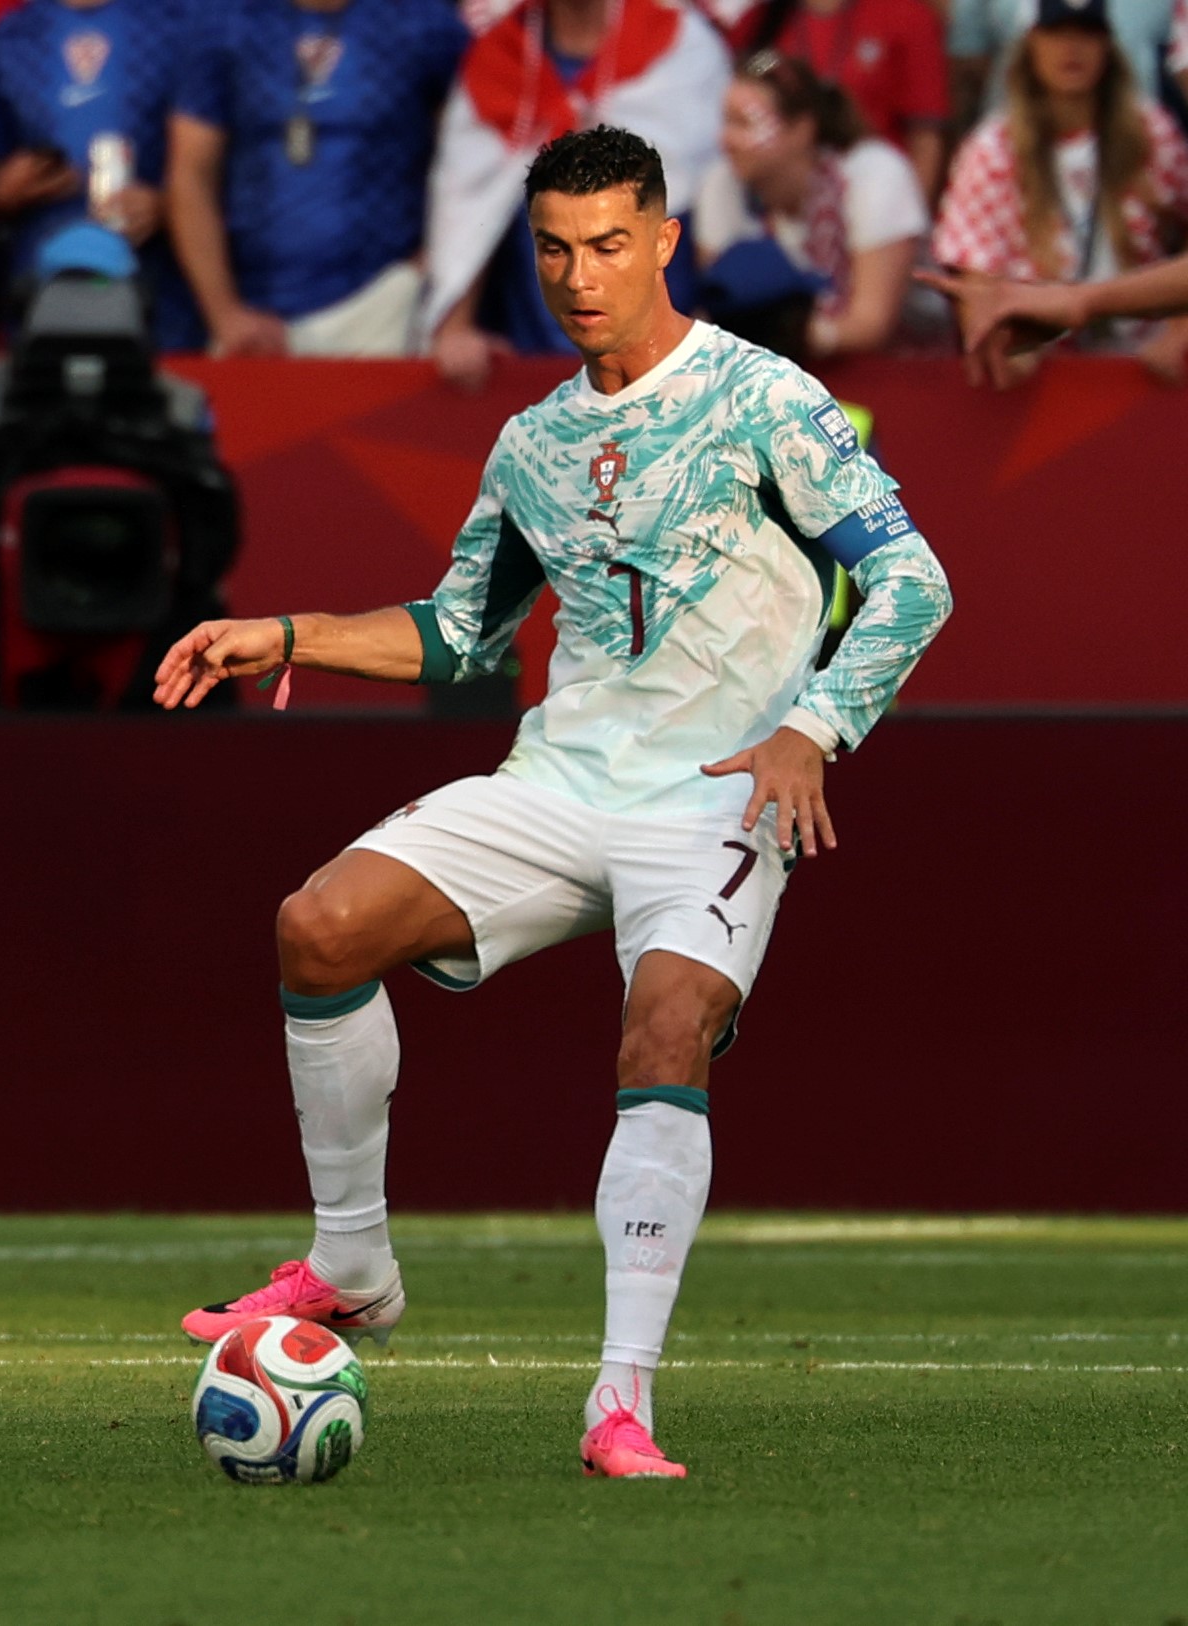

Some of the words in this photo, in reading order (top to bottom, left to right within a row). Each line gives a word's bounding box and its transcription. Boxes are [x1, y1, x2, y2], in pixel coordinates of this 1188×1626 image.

[856, 491, 902, 519] UNITE
[607, 563, 644, 655] 7
[718, 840, 759, 901] 7
